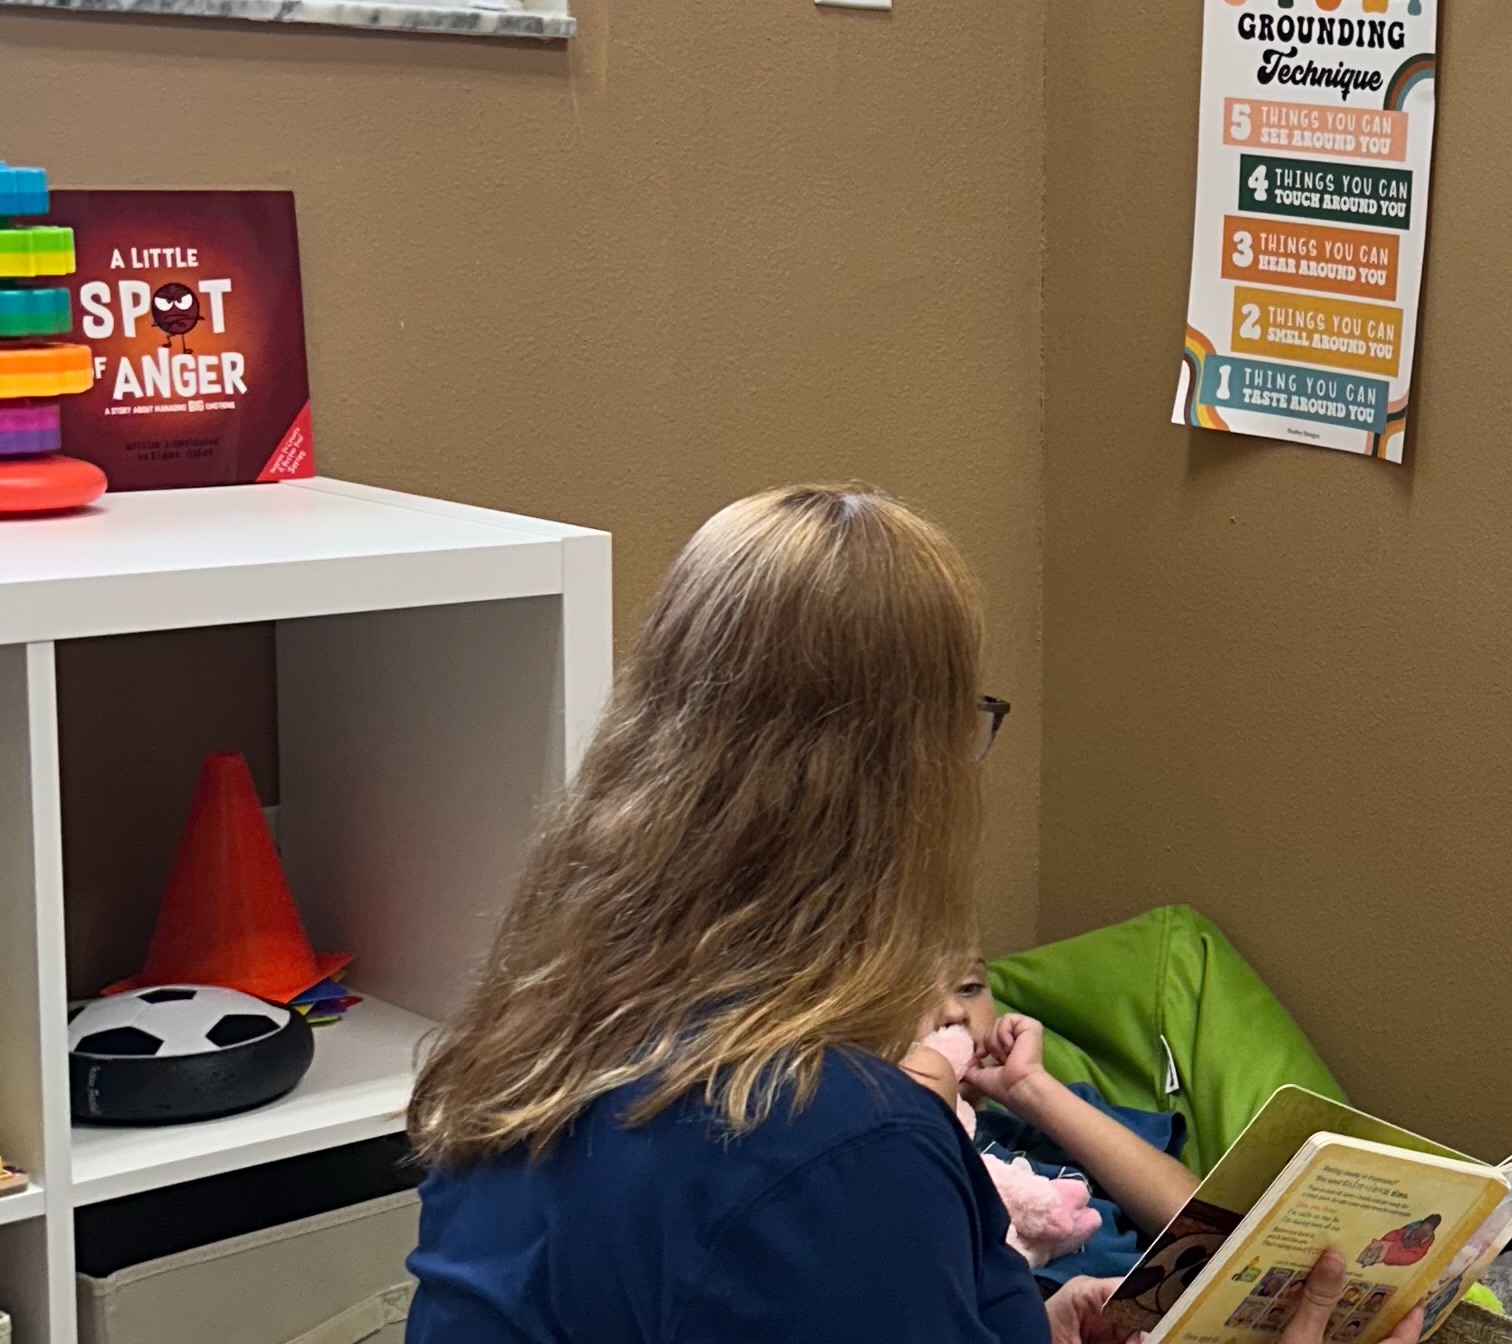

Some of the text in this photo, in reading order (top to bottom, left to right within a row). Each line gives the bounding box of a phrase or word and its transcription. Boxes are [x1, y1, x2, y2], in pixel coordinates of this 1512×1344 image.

[1238, 13, 1405, 49] GROUNDING
[1257, 46, 1383, 101] Technique
[1230, 104, 1392, 140] 5 THINGS YOU CAN
[1260, 128, 1391, 154] SEE AROUND YOU
[1248, 165, 1408, 201] 4 THINGS YOU CAN
[1275, 189, 1406, 218] TOUCH AROUND YOU
[110, 247, 198, 269] A LITTLE
[1232, 231, 1388, 267] 3 THINGS YOU CAN
[1258, 255, 1387, 285] HEAR AROUND YOU
[1240, 304, 1394, 341] 2 THINGS YOU CAN
[1267, 327, 1393, 359] SMELL AROUND YOU
[93, 347, 248, 400] F ANGER
[1216, 365, 1376, 404] 1 THING YOU CAN
[1243, 388, 1374, 424] TASTE AROUND YOU
